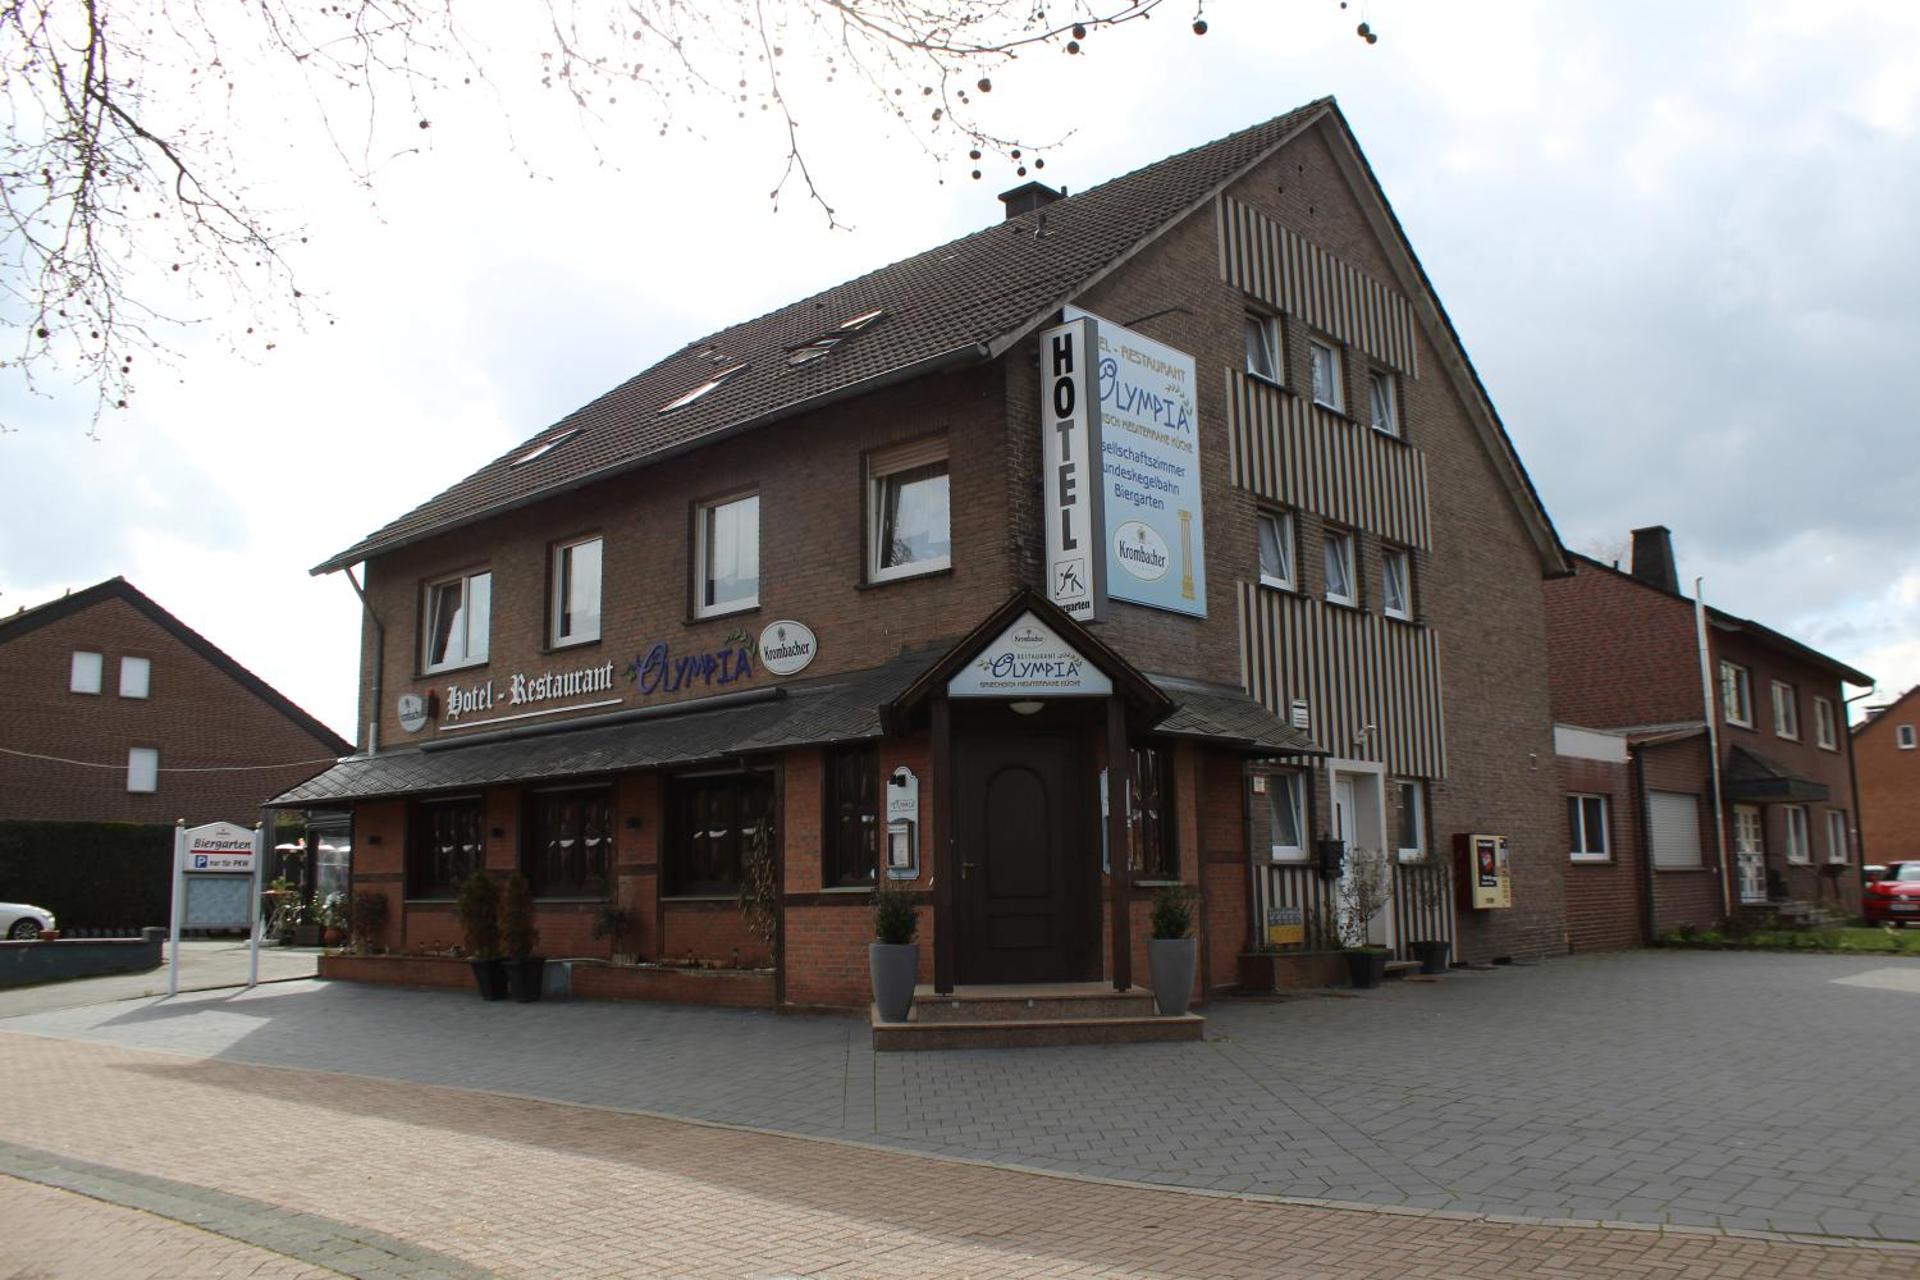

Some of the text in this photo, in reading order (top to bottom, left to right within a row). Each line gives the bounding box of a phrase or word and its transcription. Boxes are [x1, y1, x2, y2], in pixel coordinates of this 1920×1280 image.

[1120, 345, 1186, 383] RESTAURANT
[1098, 358, 1190, 434] OLYMPIA
[1052, 332, 1077, 551] HOTEL
[1114, 483, 1165, 511] Biergarten
[1119, 540, 1166, 569] Krombacher
[635, 639, 753, 695] OLYMPIA
[764, 640, 810, 662] Krombacher
[988, 652, 1079, 678] OLYMPIA
[446, 680, 493, 721] Hotel
[509, 658, 614, 705] Restaurant
[193, 838, 251, 851] Biergarten
